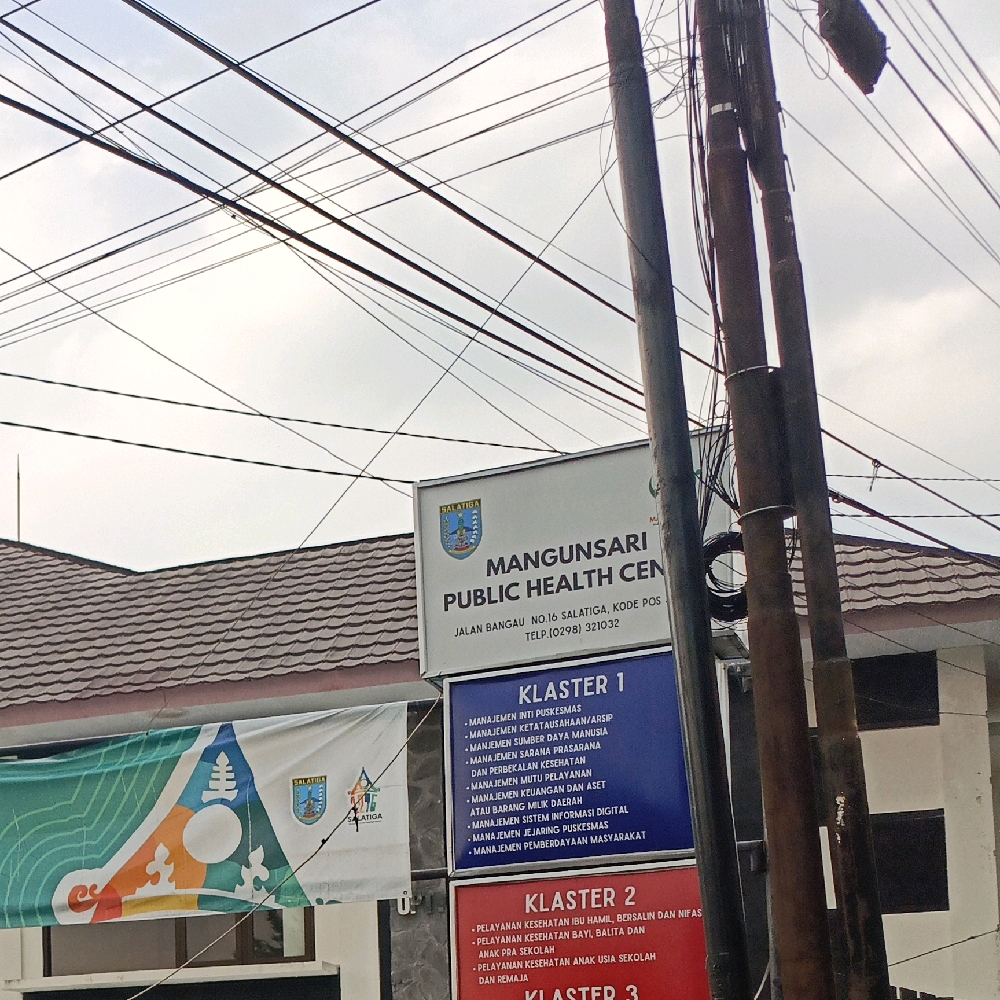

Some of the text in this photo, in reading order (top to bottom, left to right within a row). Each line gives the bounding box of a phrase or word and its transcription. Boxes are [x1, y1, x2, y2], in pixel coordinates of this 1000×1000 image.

[441, 500, 480, 514] SALATIGA
[487, 532, 647, 576] MANGUNSARI
[444, 559, 664, 611] PUBLIC HEALTH CEN
[455, 596, 661, 637] JALAN BANGAU NO.16 SALATIGA, KODE POS
[586, 619, 619, 631] 321032
[519, 672, 623, 704] KLASTER 1
[469, 704, 581, 726] MANAJEMEN INTI PUSKESMAS
[470, 725, 516, 738] MANAJEMEN
[470, 727, 608, 752] MANJEMEN SUMBER DAYA MANUSIA
[470, 741, 601, 764] MANAJEMEN SARANA PRASARANA
[472, 756, 585, 777] DAN PERBEKALAN KESEHATAN
[294, 776, 326, 786] SALATIGA
[471, 769, 591, 790] MANAJEMEN MUTU PELAYANAN
[472, 781, 606, 803] MANAJEMEN KEUANGAN DAN ASET
[470, 797, 582, 816] ATAU BARANG MILIK DAERAH
[472, 806, 628, 829] MANAJEMEN SISTEM INFORMASI DIGITAL
[473, 821, 608, 841] MANAJEMEN JEJARING PUSKESMAS
[474, 831, 645, 855] MANAJEMEN PEMBERDAYAAN MASYARAKAT
[526, 886, 635, 913] KLASTER 2
[477, 909, 702, 932] PELAYANAN KESEHATAN IBU HAMIL, BERSALIN DAN NIFAS
[477, 926, 645, 946] PELAYANAN KESEHATAN BAYI, BALITA DAN
[478, 953, 656, 971] PELAYANAN KESEHATAN ANAK USIA SEKOLAH
[479, 946, 554, 958] ANAK PRA SEKOLAH
[479, 974, 528, 984] DAN REMAJA
